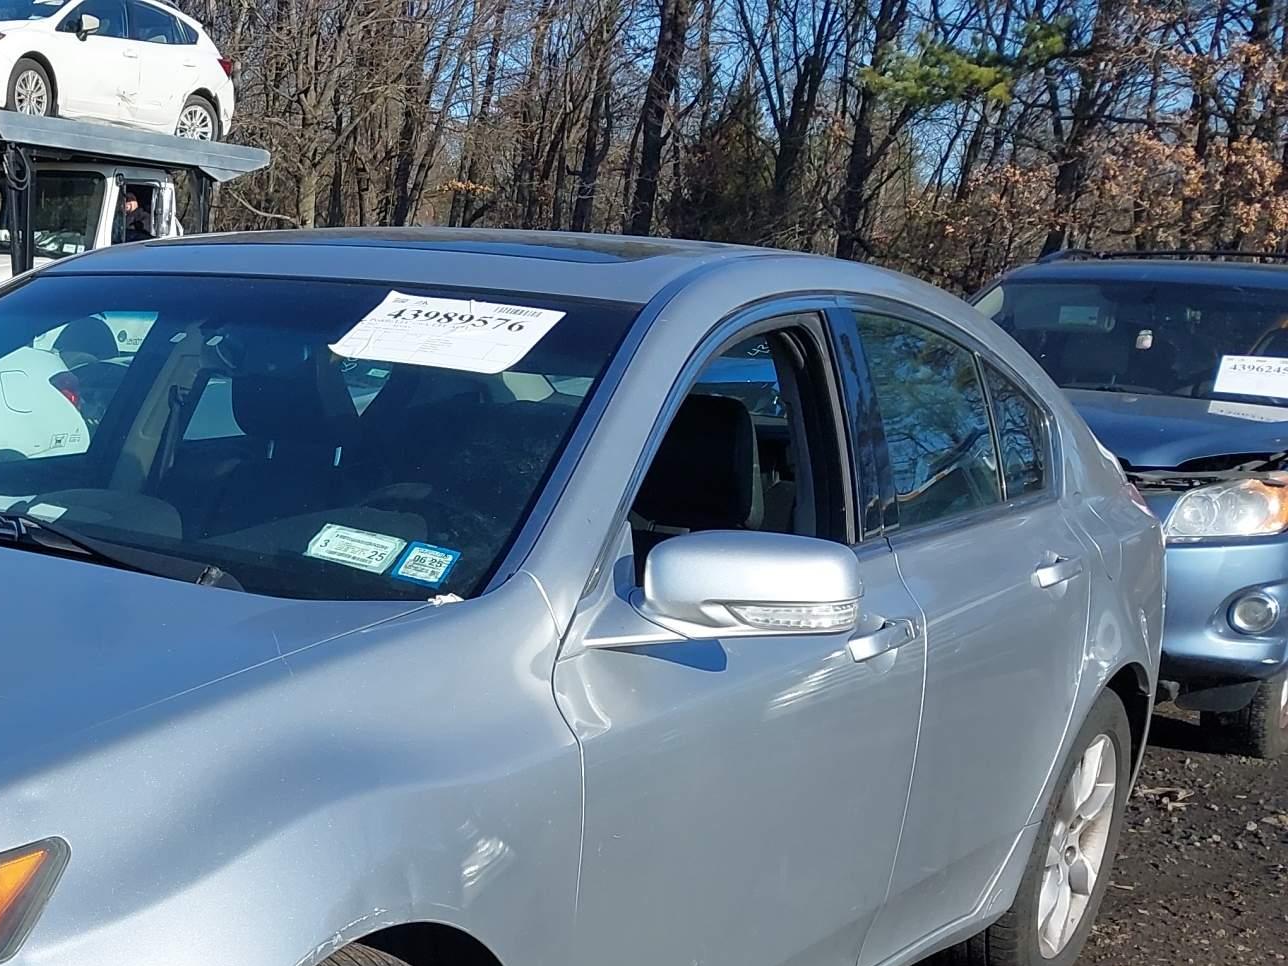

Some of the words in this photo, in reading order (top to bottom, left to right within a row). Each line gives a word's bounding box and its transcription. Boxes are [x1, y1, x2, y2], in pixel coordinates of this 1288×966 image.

[387, 308, 528, 333] 43989576
[320, 539, 330, 548] 3
[367, 550, 387, 562] 25
[413, 554, 428, 564] 06
[428, 557, 443, 568] 25
